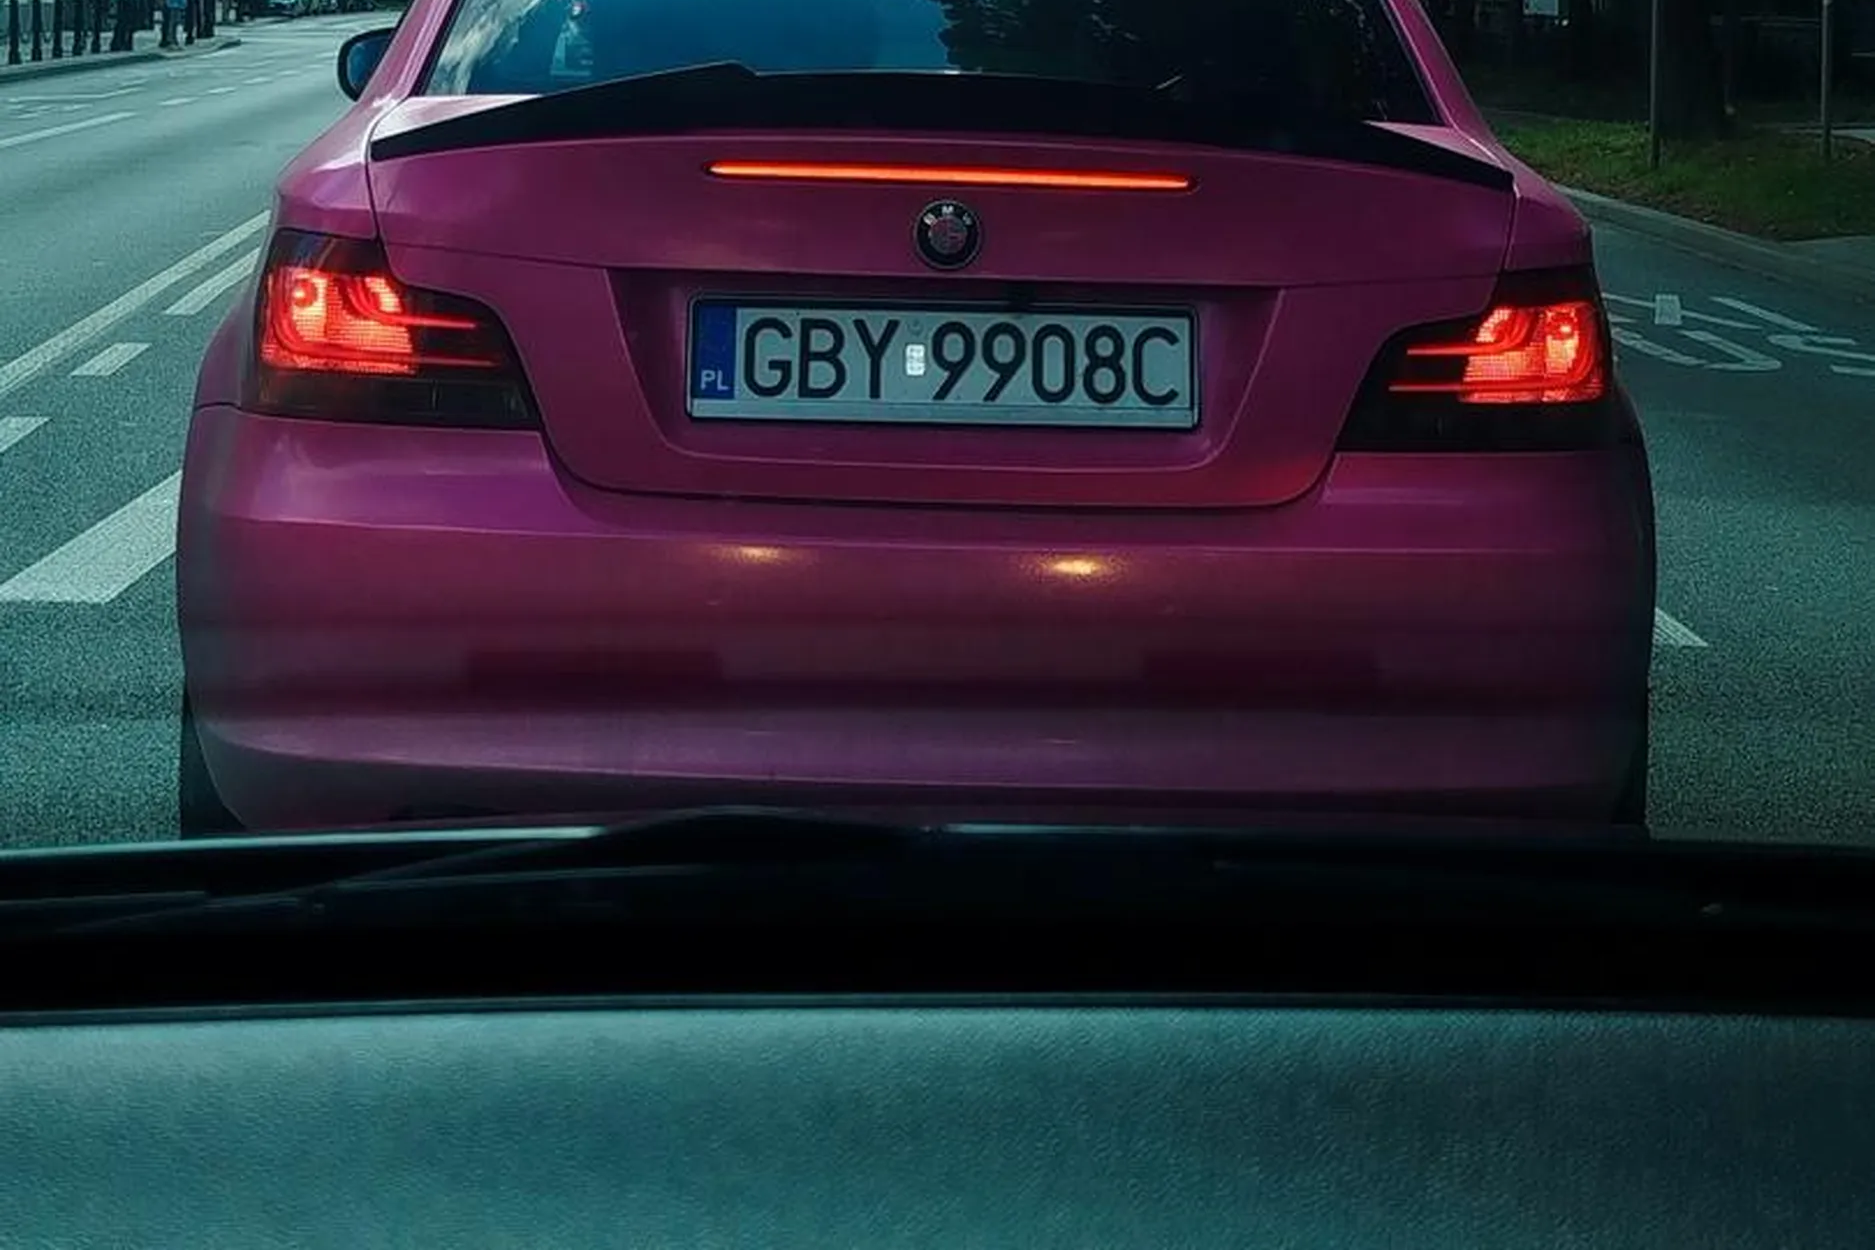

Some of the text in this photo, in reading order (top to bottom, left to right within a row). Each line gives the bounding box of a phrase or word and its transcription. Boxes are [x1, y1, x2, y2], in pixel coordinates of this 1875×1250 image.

[700, 370, 730, 392] PL
[742, 316, 1181, 406] GBY 9908C
